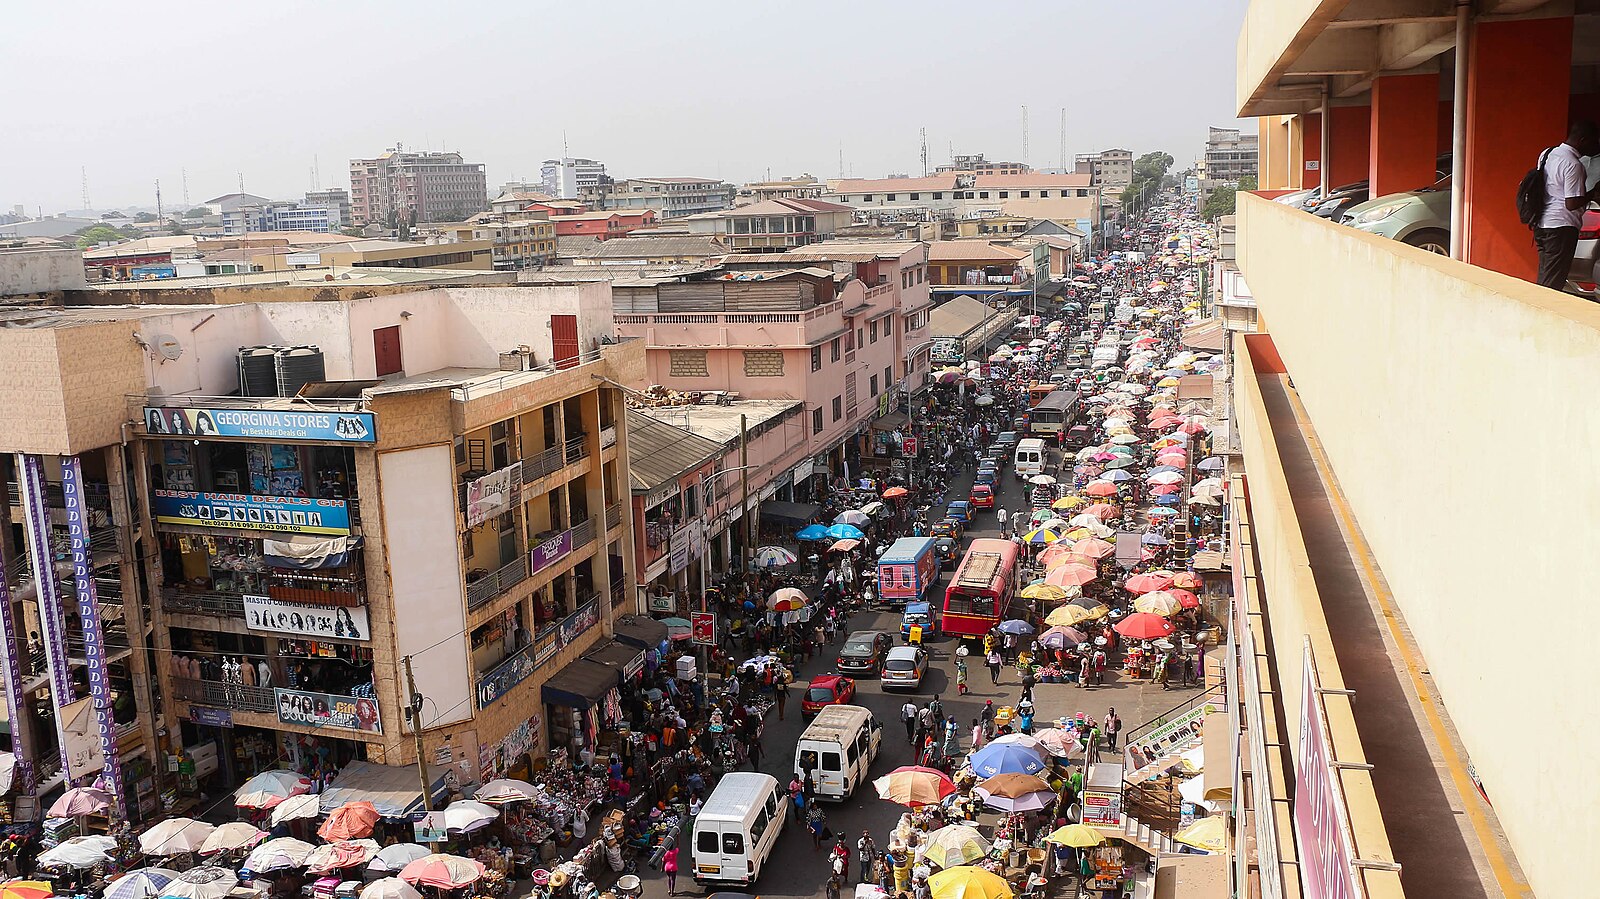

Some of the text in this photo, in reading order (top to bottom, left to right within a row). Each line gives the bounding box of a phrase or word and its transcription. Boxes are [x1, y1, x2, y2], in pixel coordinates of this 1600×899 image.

[217, 412, 330, 429] GEORGINA STORES
[241, 427, 249, 436] by
[265, 428, 277, 436] Hair
[279, 429, 295, 437] Deals
[155, 489, 345, 508] BEST HAIR DEALS GH
[1148, 708, 1203, 741] AFRIPRIDE WIG SHOP
